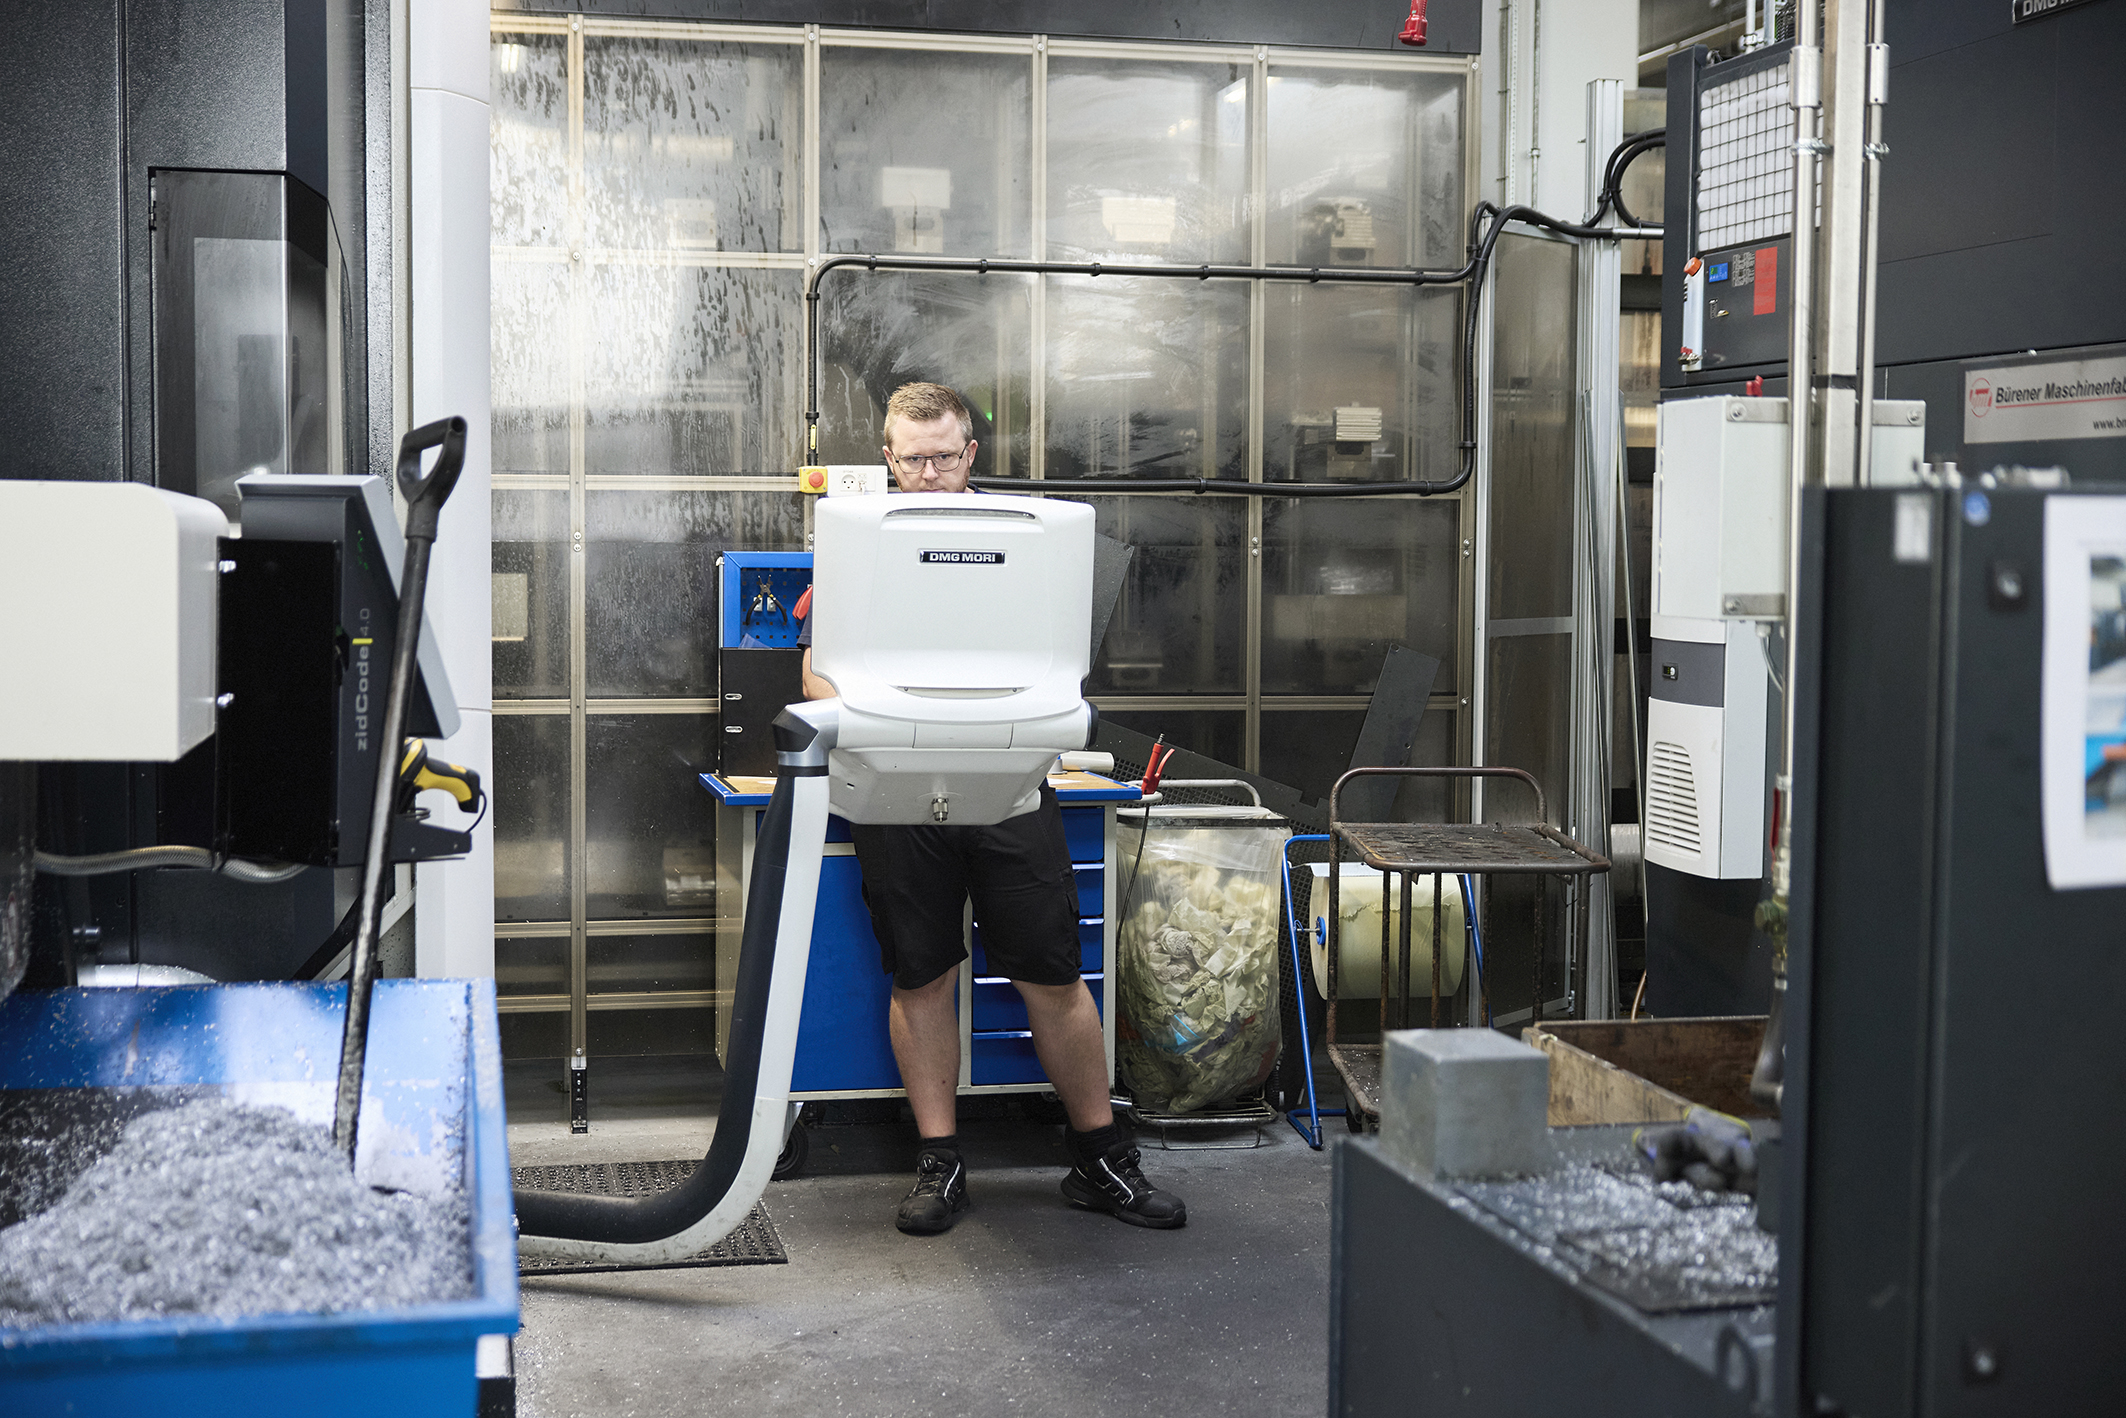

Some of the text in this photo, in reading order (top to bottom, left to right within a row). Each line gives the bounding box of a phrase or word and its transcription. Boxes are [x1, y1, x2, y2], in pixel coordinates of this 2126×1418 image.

[1995, 387, 2042, 403] Bürener
[929, 552, 996, 563] DMG MORI
[355, 608, 370, 751] zidCode 4.0
